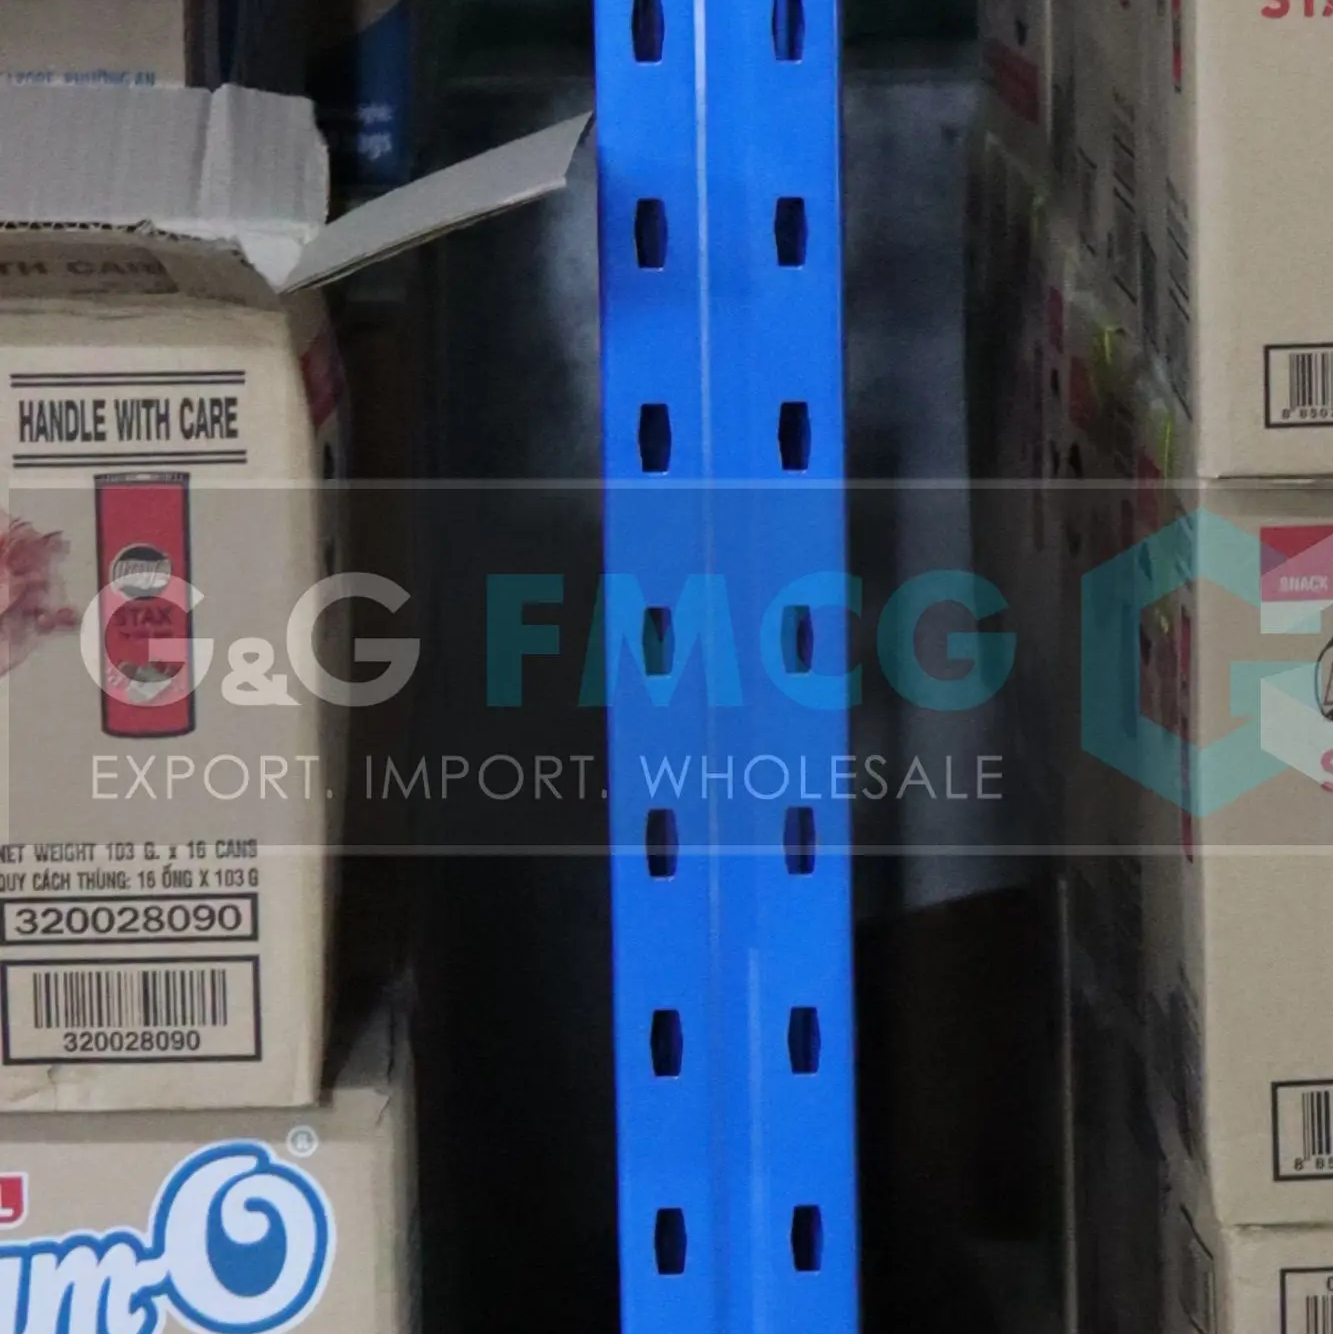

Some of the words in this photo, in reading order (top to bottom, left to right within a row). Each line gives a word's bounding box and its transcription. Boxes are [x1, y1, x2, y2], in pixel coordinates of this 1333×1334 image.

[20, 400, 106, 441] HANDLE
[115, 399, 170, 440] WITH
[180, 398, 237, 439] CARE
[35, 842, 96, 862] WEIGHT
[107, 841, 134, 861] 103
[187, 840, 206, 859] 16
[216, 839, 257, 858] CANS
[16, 905, 241, 935] 320028090
[64, 1030, 200, 1052] 320028090
